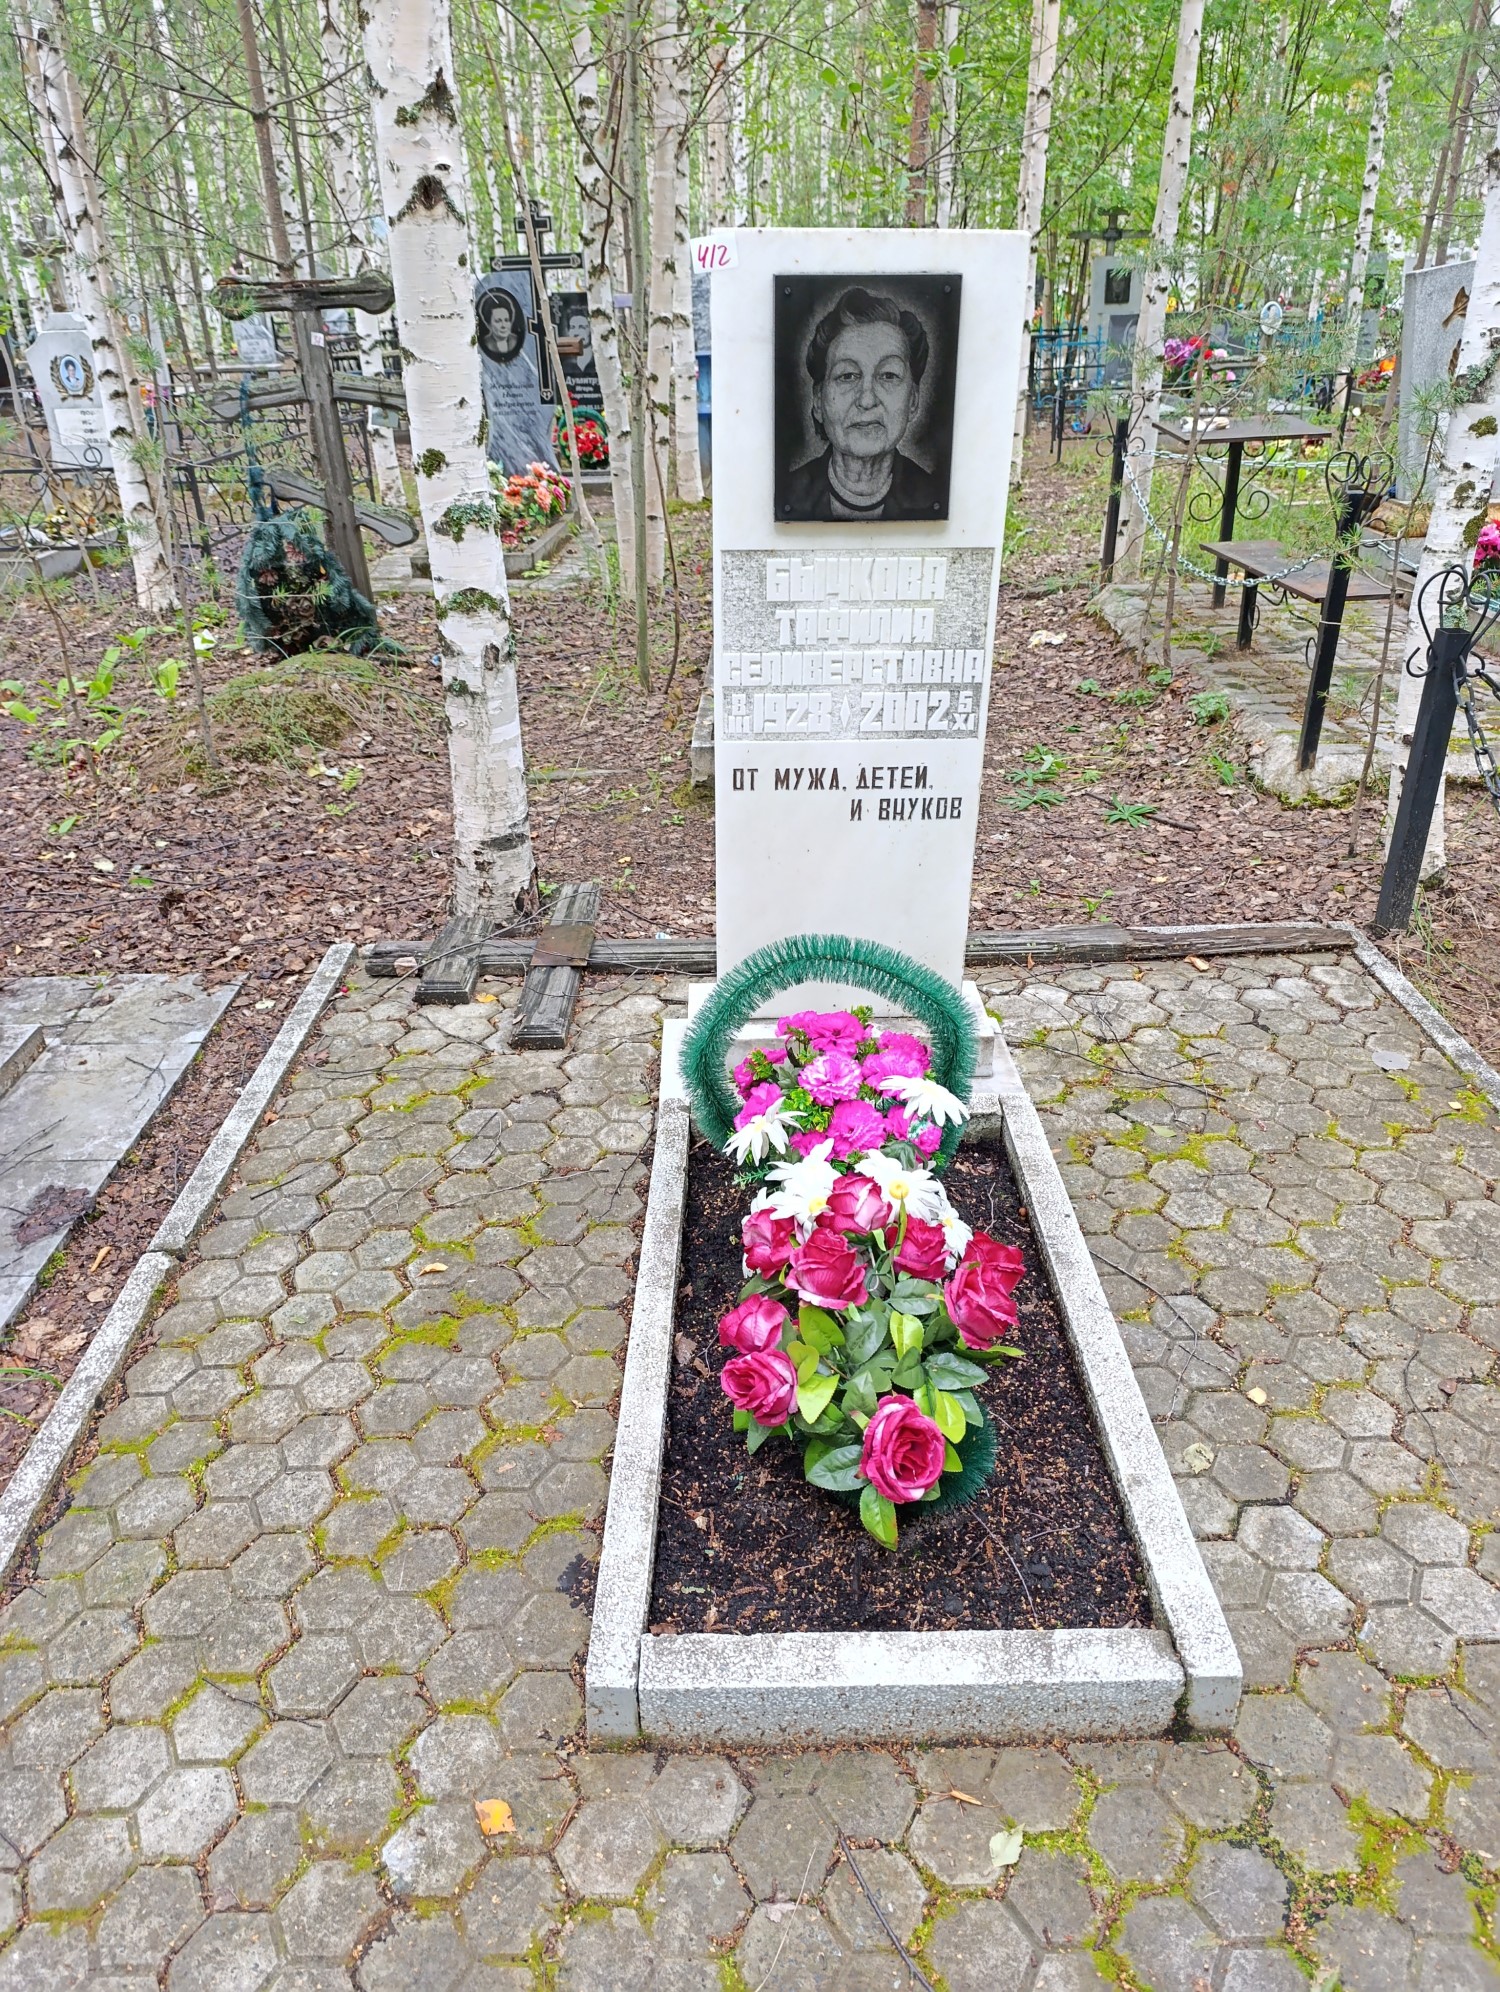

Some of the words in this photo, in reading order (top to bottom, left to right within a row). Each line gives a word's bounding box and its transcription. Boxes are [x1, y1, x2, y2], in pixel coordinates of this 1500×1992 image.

[698, 244, 731, 269] 412
[766, 557, 947, 601] БЫЧКОВА
[774, 606, 935, 646] ТАФИЛИЯ
[722, 650, 985, 687] СЕЛИВЕРСТОВНА
[753, 692, 832, 733] 1928
[860, 690, 951, 732] 2002
[732, 768, 759, 791] ОТ
[850, 798, 863, 821] И
[878, 797, 963, 821] ВНУКОВ
